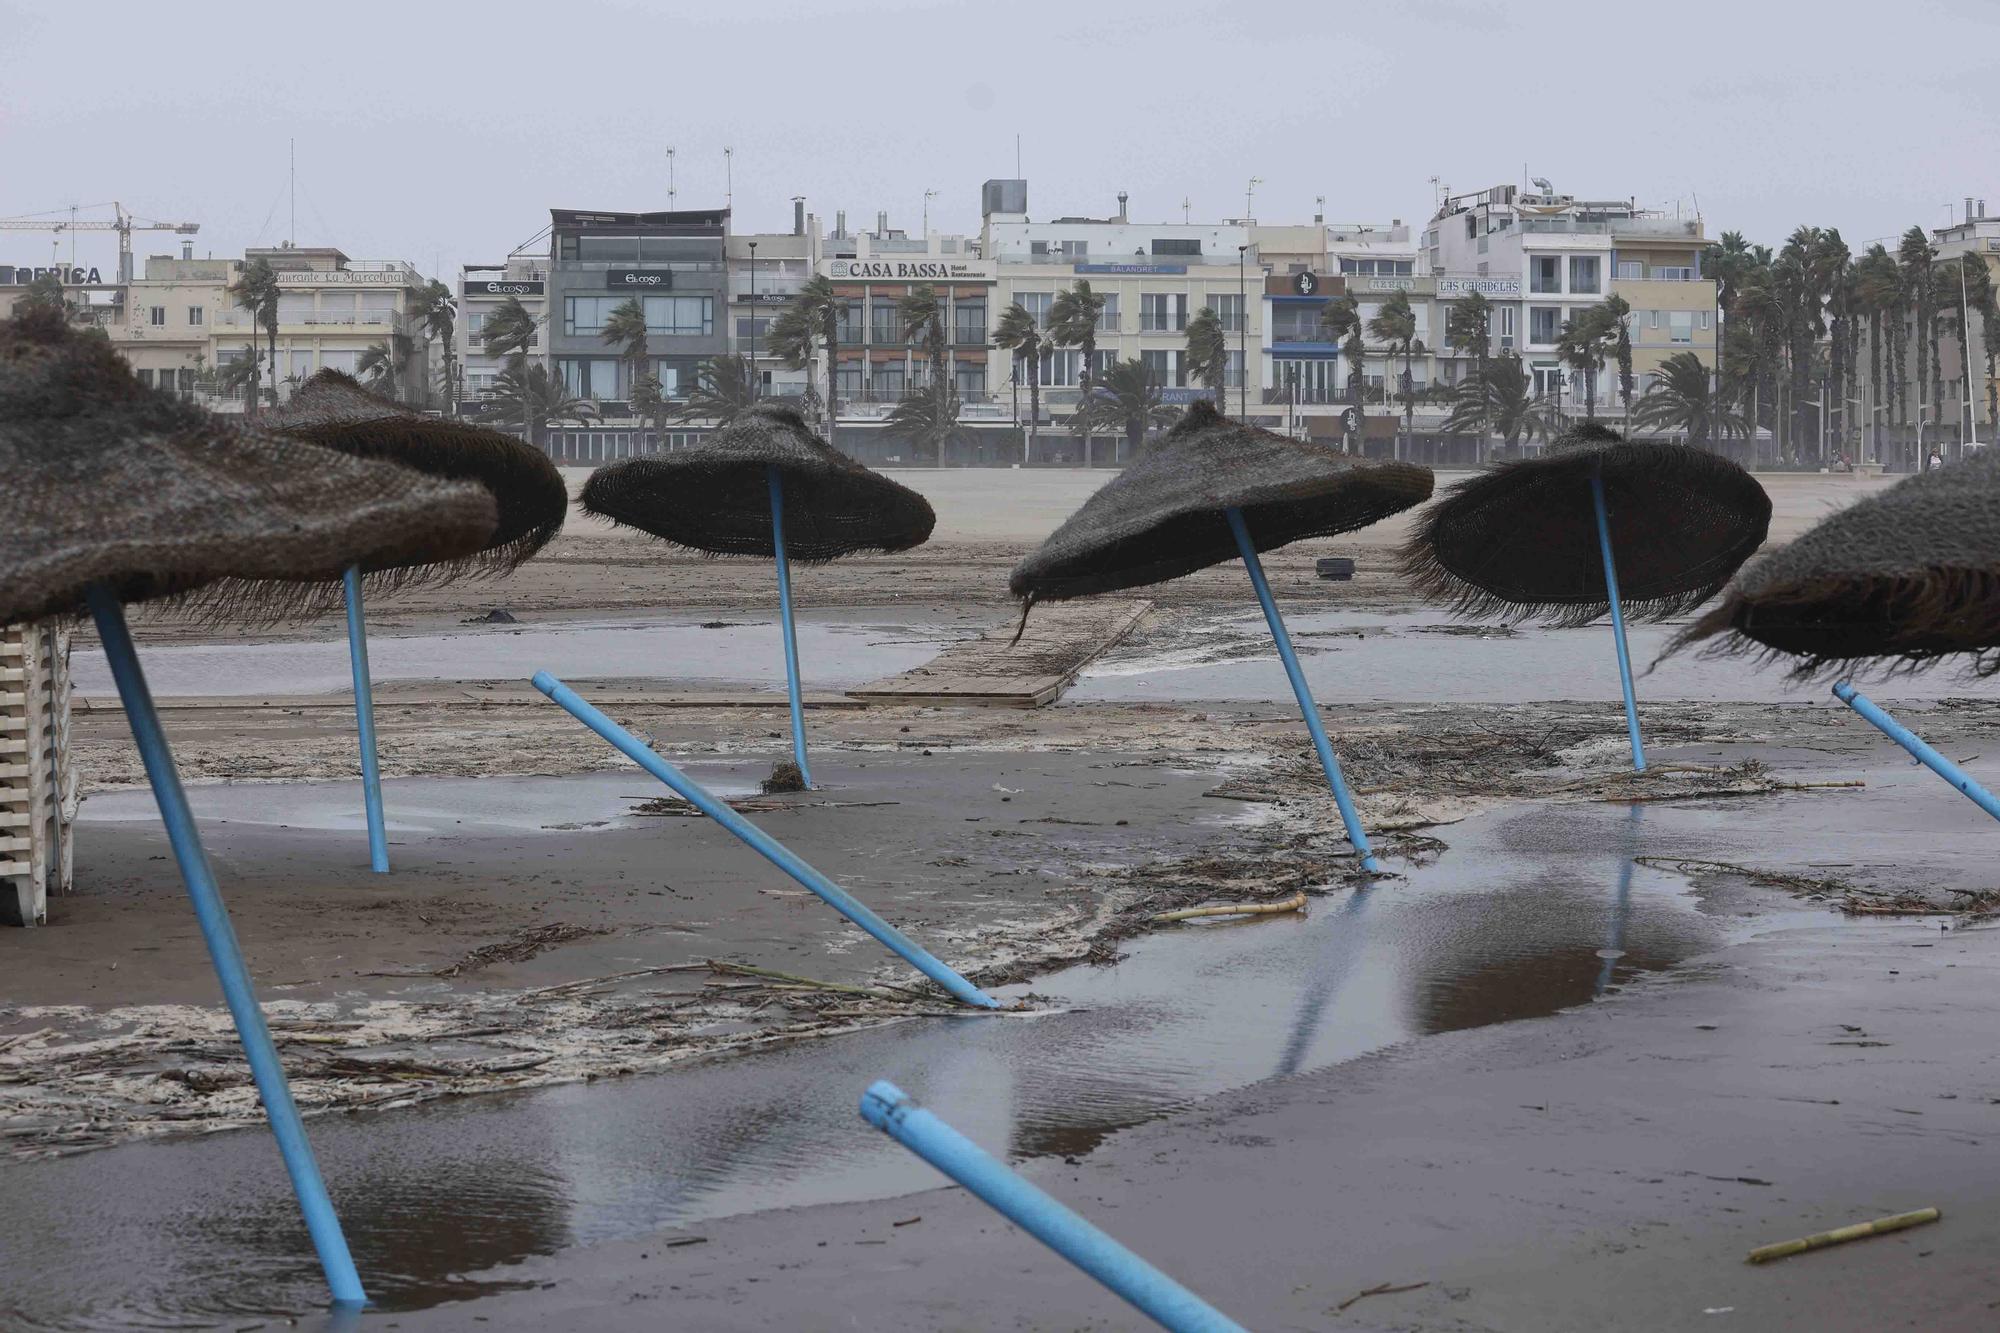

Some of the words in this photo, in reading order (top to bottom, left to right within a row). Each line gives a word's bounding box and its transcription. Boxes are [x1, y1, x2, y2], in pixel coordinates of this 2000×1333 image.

[849, 263, 893, 278] CASA
[897, 263, 949, 278] BASSA
[1110, 265, 1158, 273] BALANDRET
[277, 272, 319, 282] aurante
[1440, 281, 1459, 292] LAS
[1462, 281, 1519, 292] CARABELAS
